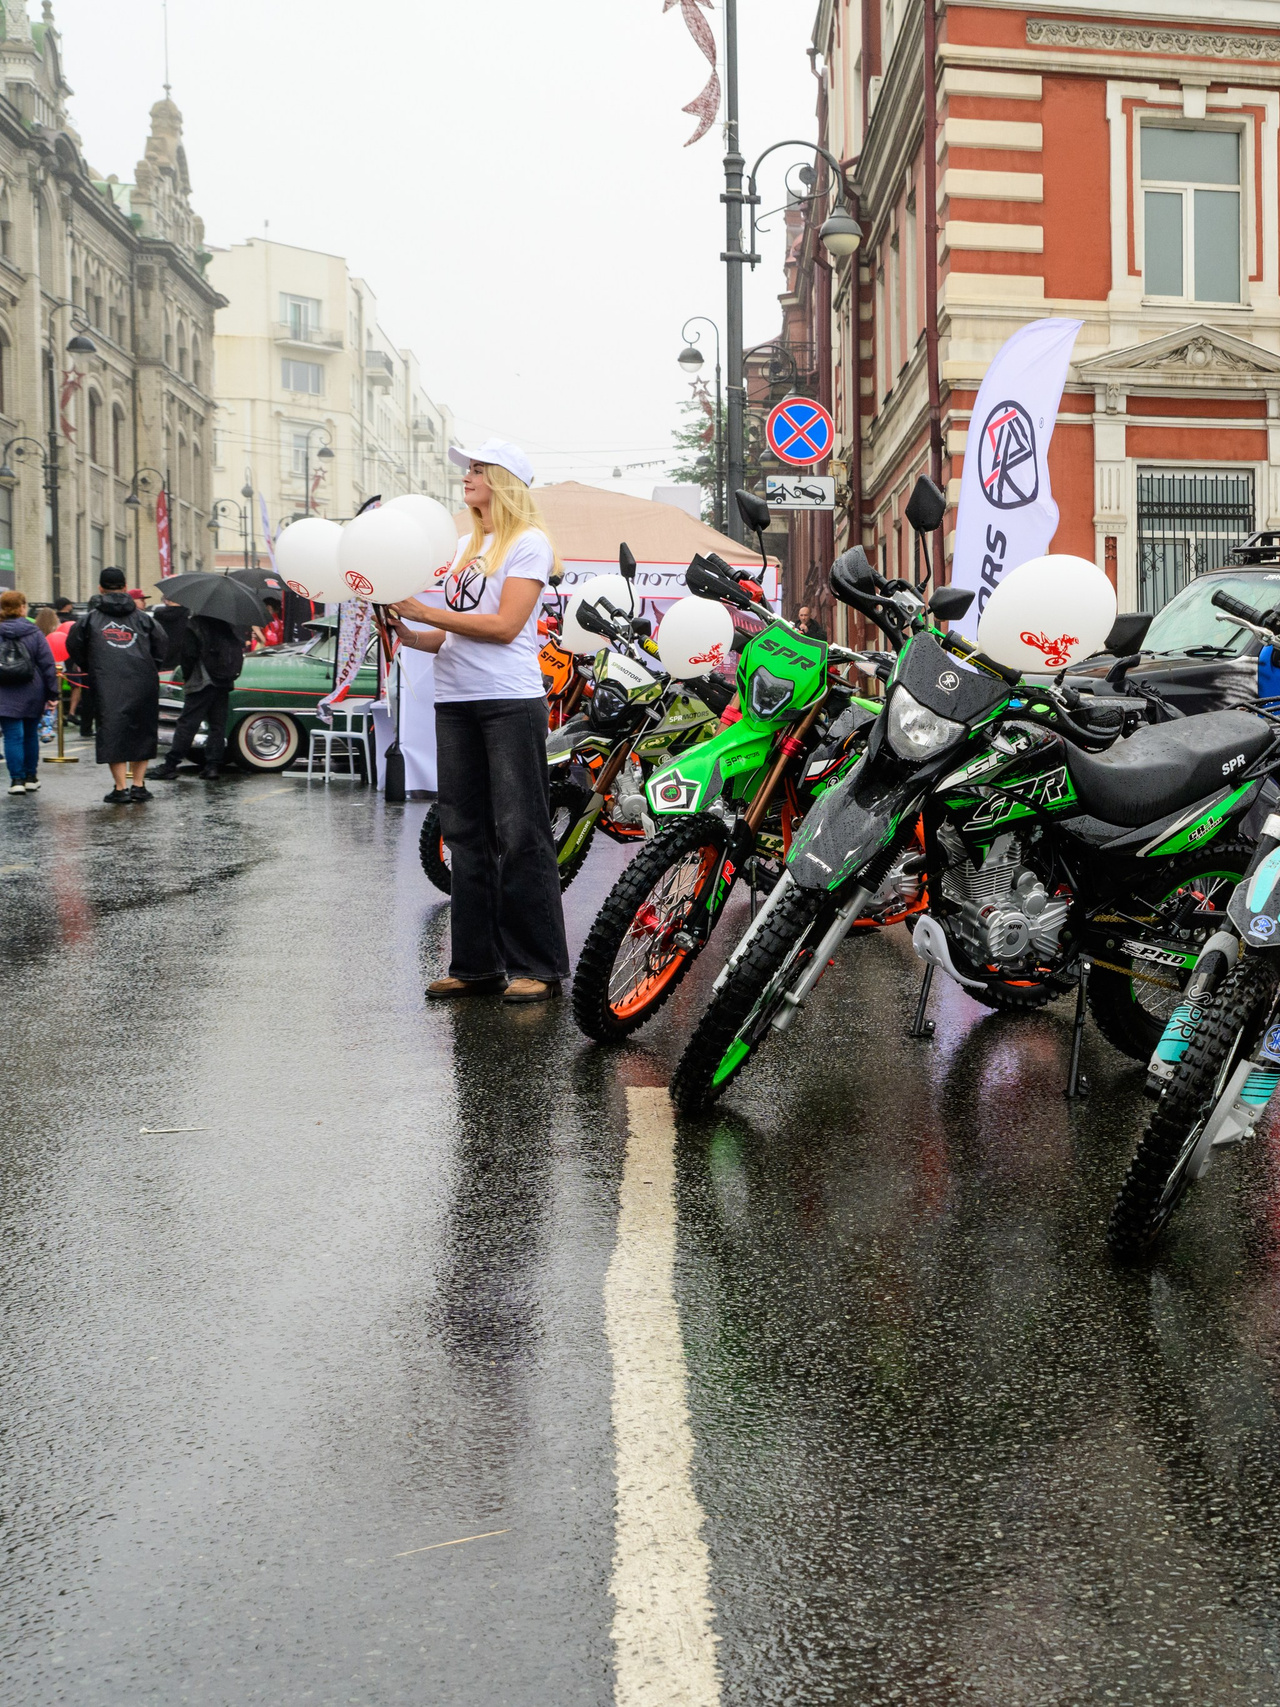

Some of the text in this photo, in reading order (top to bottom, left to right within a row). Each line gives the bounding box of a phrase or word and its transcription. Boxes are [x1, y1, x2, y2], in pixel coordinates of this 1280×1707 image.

[977, 524, 1007, 629] ORS
[541, 651, 566, 670] SPR
[758, 639, 817, 671] SPR
[669, 710, 710, 723] SPRMOTORS
[725, 754, 743, 767] SPR
[1222, 754, 1246, 776] SPR
[1170, 984, 1213, 1043] SPR
